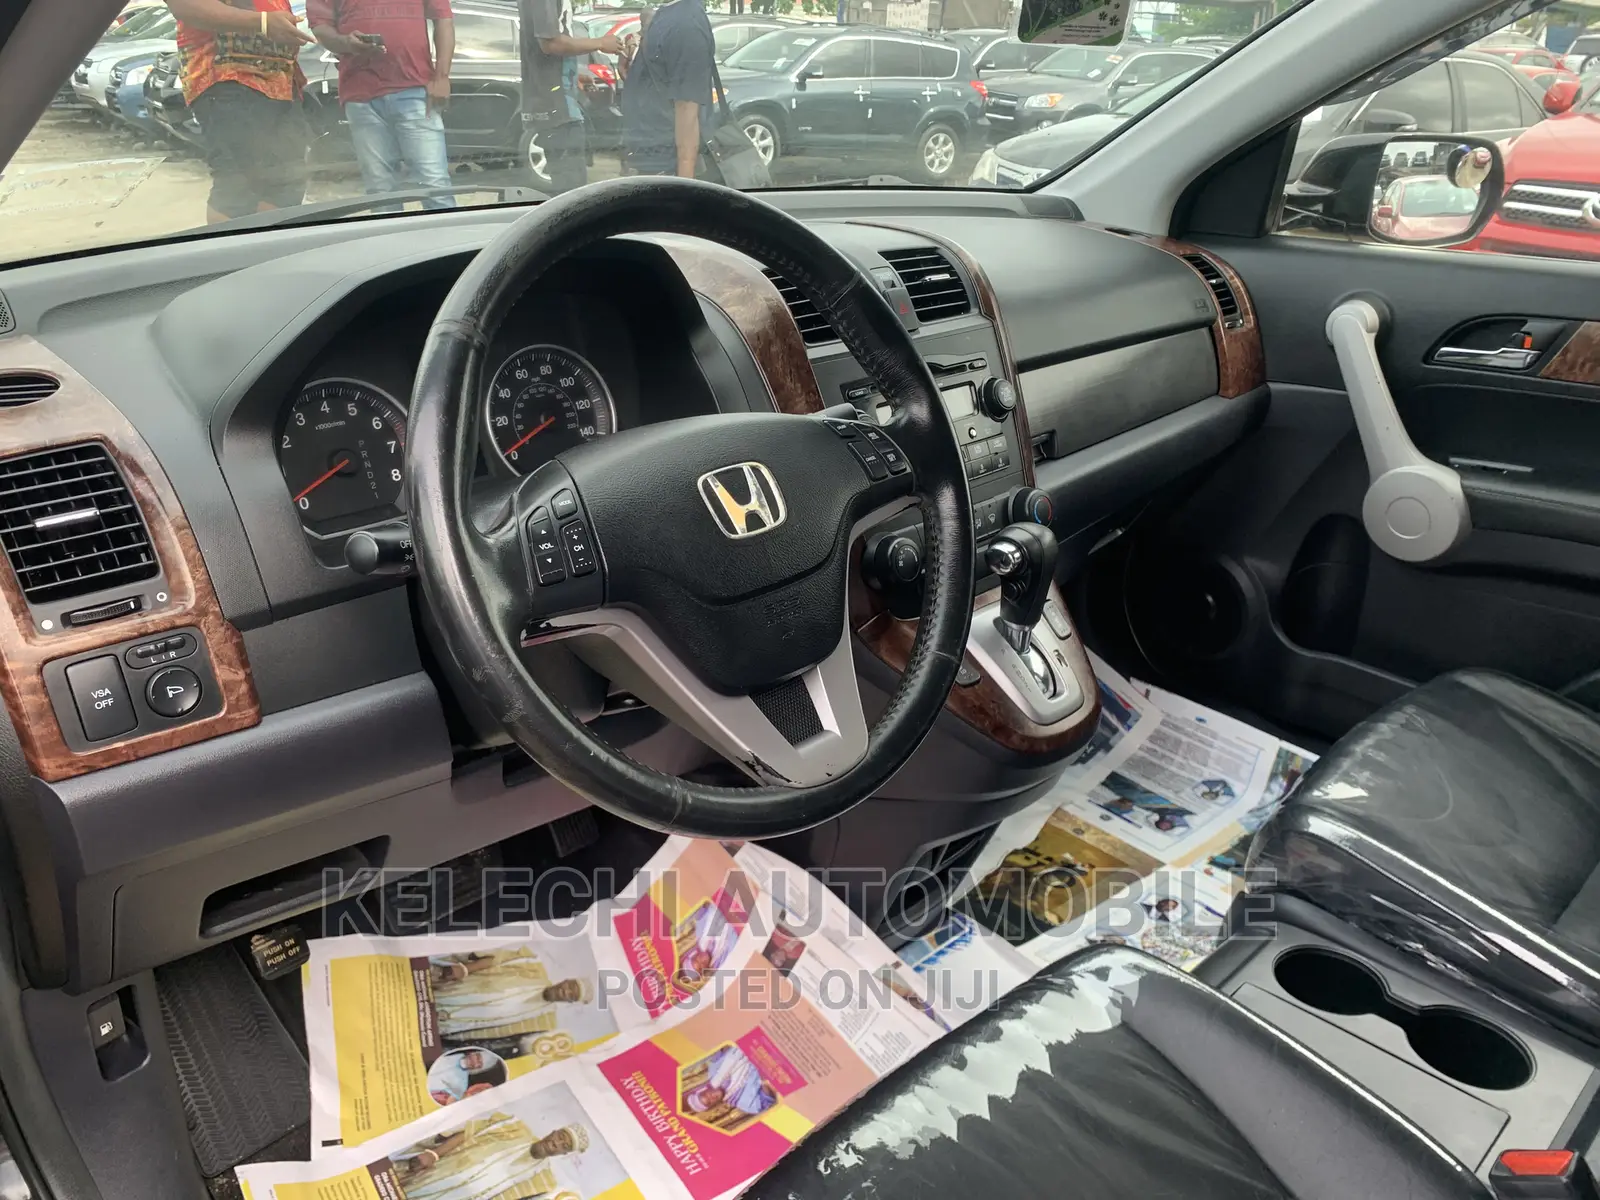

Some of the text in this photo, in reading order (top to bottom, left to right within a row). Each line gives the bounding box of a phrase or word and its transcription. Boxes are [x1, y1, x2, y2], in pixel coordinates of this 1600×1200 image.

[515, 369, 529, 380] 60
[540, 365, 552, 376] 80
[560, 376, 575, 388] 100
[498, 388, 511, 399] 40
[320, 400, 331, 413] 4
[347, 403, 358, 416] 5
[575, 398, 591, 410] 120
[295, 412, 306, 426] 3
[372, 416, 383, 430] 6
[495, 415, 509, 427] 20
[579, 425, 595, 437] 140
[282, 435, 292, 449] 2
[386, 440, 397, 454] 7
[510, 450, 518, 460] 0
[391, 468, 401, 482] 8
[299, 497, 310, 510] 0
[538, 541, 555, 551] VOL
[573, 544, 585, 552] CH
[91, 687, 112, 699] VSA
[94, 698, 114, 710] OFF
[263, 937, 296, 957] PUSH ON
[266, 945, 301, 967] PUSH OFF
[619, 1075, 702, 1176] HAPPY BIRTHDAY
[668, 1116, 700, 1154] GRAND
